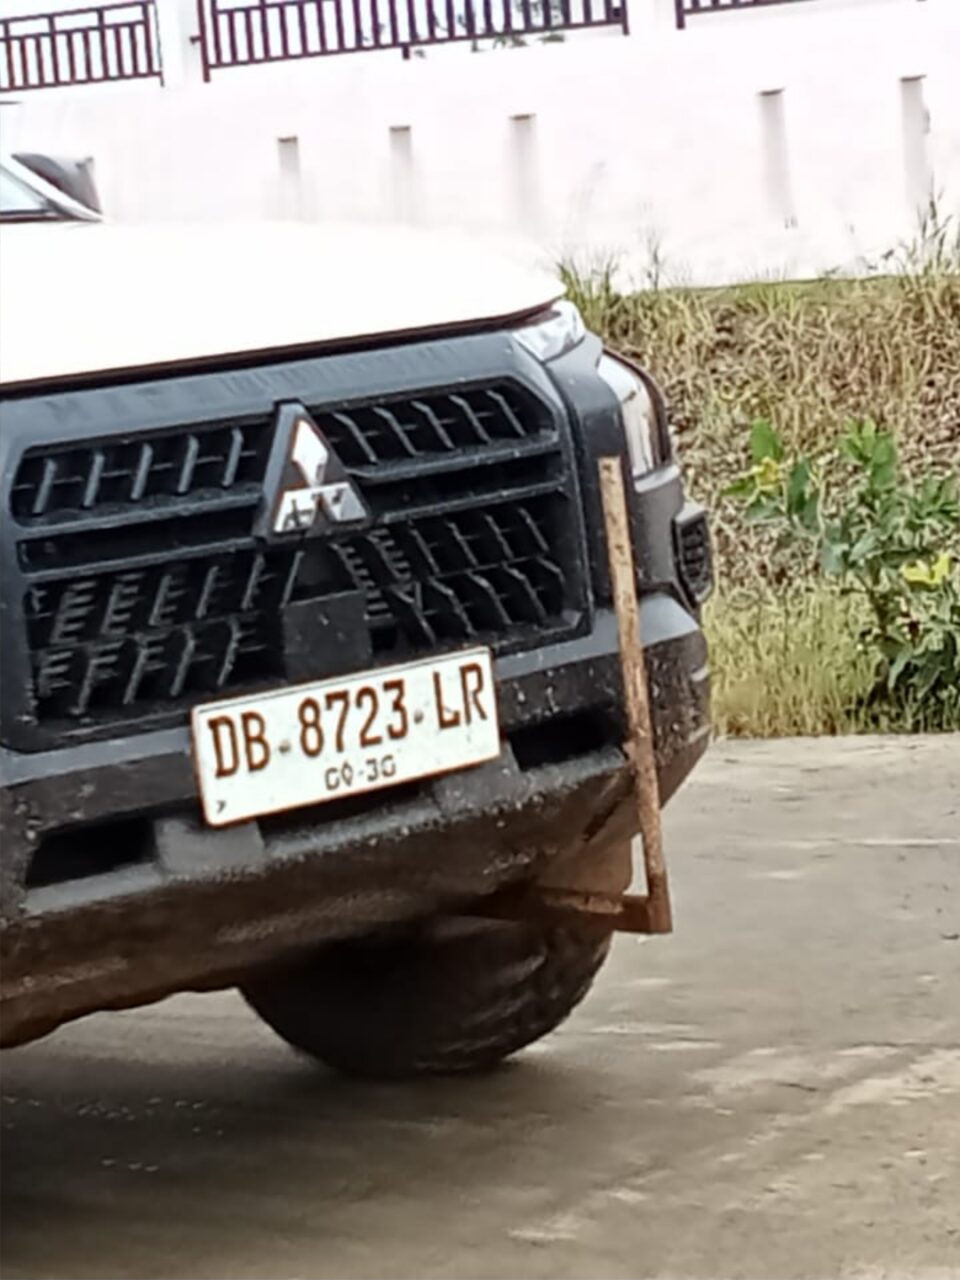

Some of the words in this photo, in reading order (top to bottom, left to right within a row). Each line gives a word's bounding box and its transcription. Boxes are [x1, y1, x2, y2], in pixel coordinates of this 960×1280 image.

[207, 711, 271, 778] DB
[298, 679, 409, 758] 8723
[433, 662, 488, 730] LR
